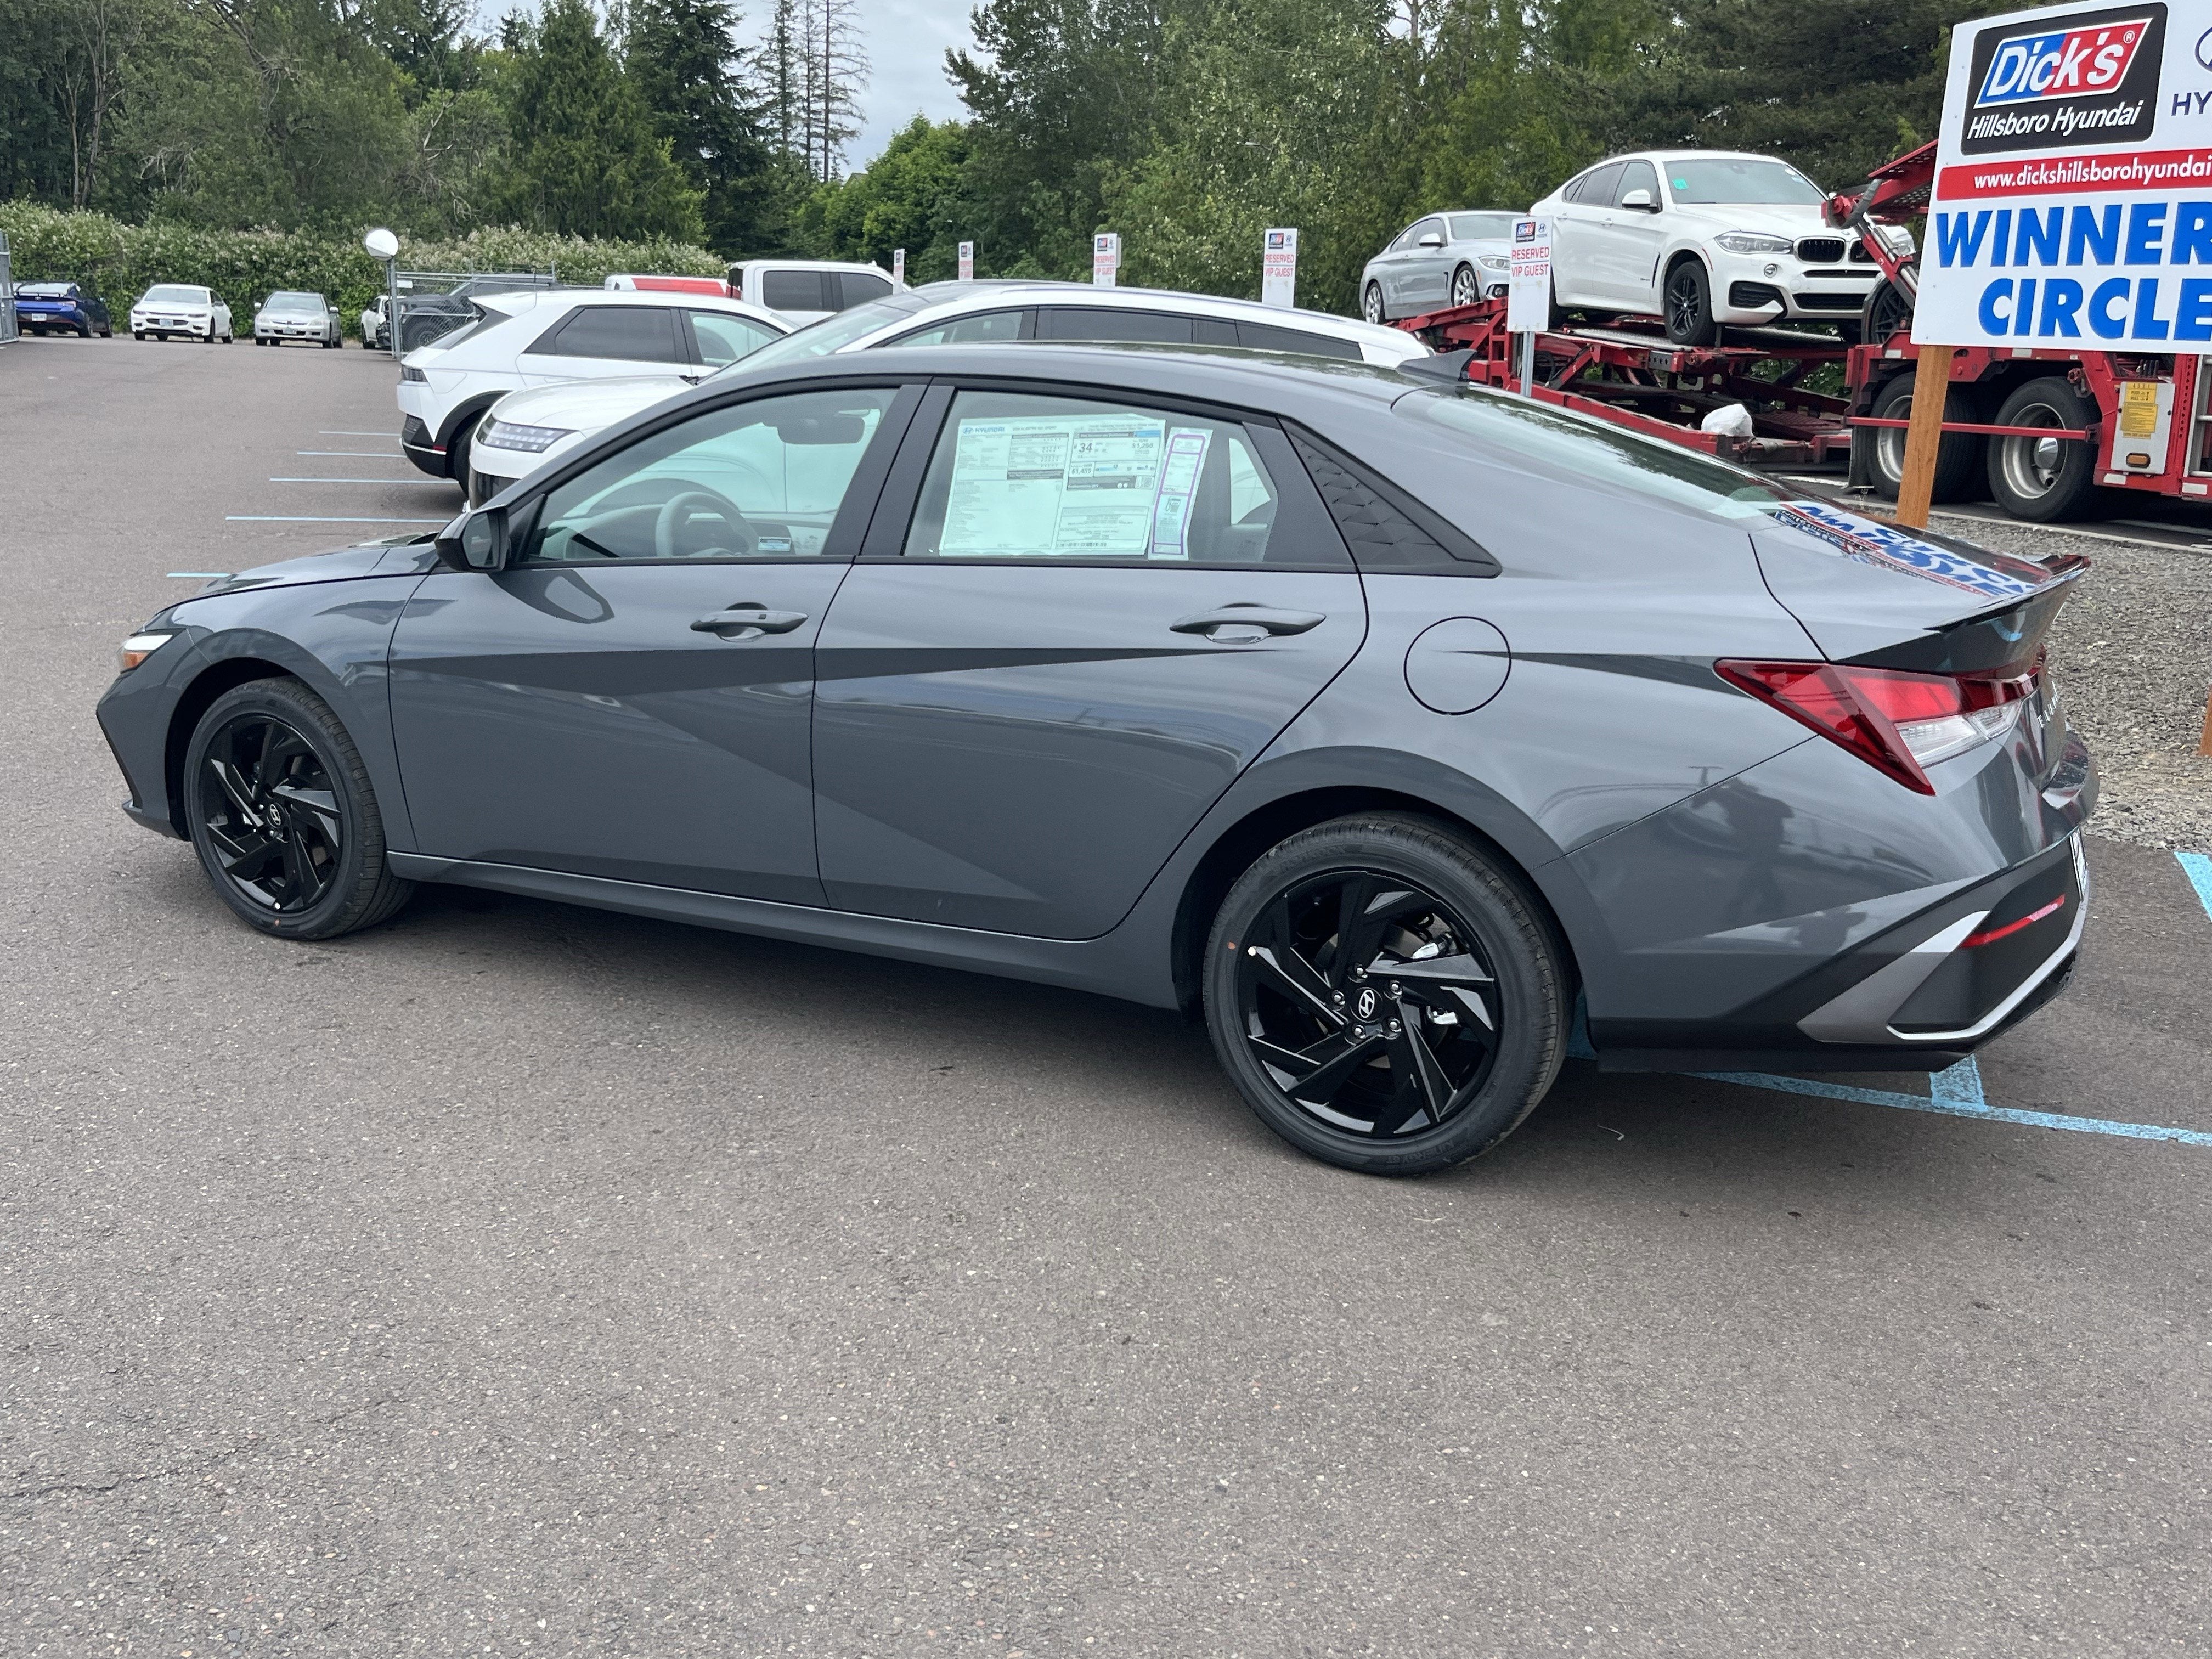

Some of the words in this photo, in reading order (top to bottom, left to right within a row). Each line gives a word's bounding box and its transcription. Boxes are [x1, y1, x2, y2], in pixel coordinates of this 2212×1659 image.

[1987, 32, 2124, 97] Dick's
[1967, 112, 2050, 139] Hillsboro
[2051, 100, 2145, 137] Hyundai
[1974, 154, 2212, 189] www.dickshillsborohyundai
[1936, 201, 2212, 268] WINNER
[1265, 254, 1295, 263] RESERVED
[1511, 246, 1550, 261] RESERVED
[1265, 267, 1273, 276] VIP
[1274, 268, 1294, 277] GUEST
[1511, 266, 1522, 277] VIP
[1524, 264, 1549, 276] GUEST
[1978, 276, 2212, 342] CIRCLE
[1079, 442, 1093, 453] 34
